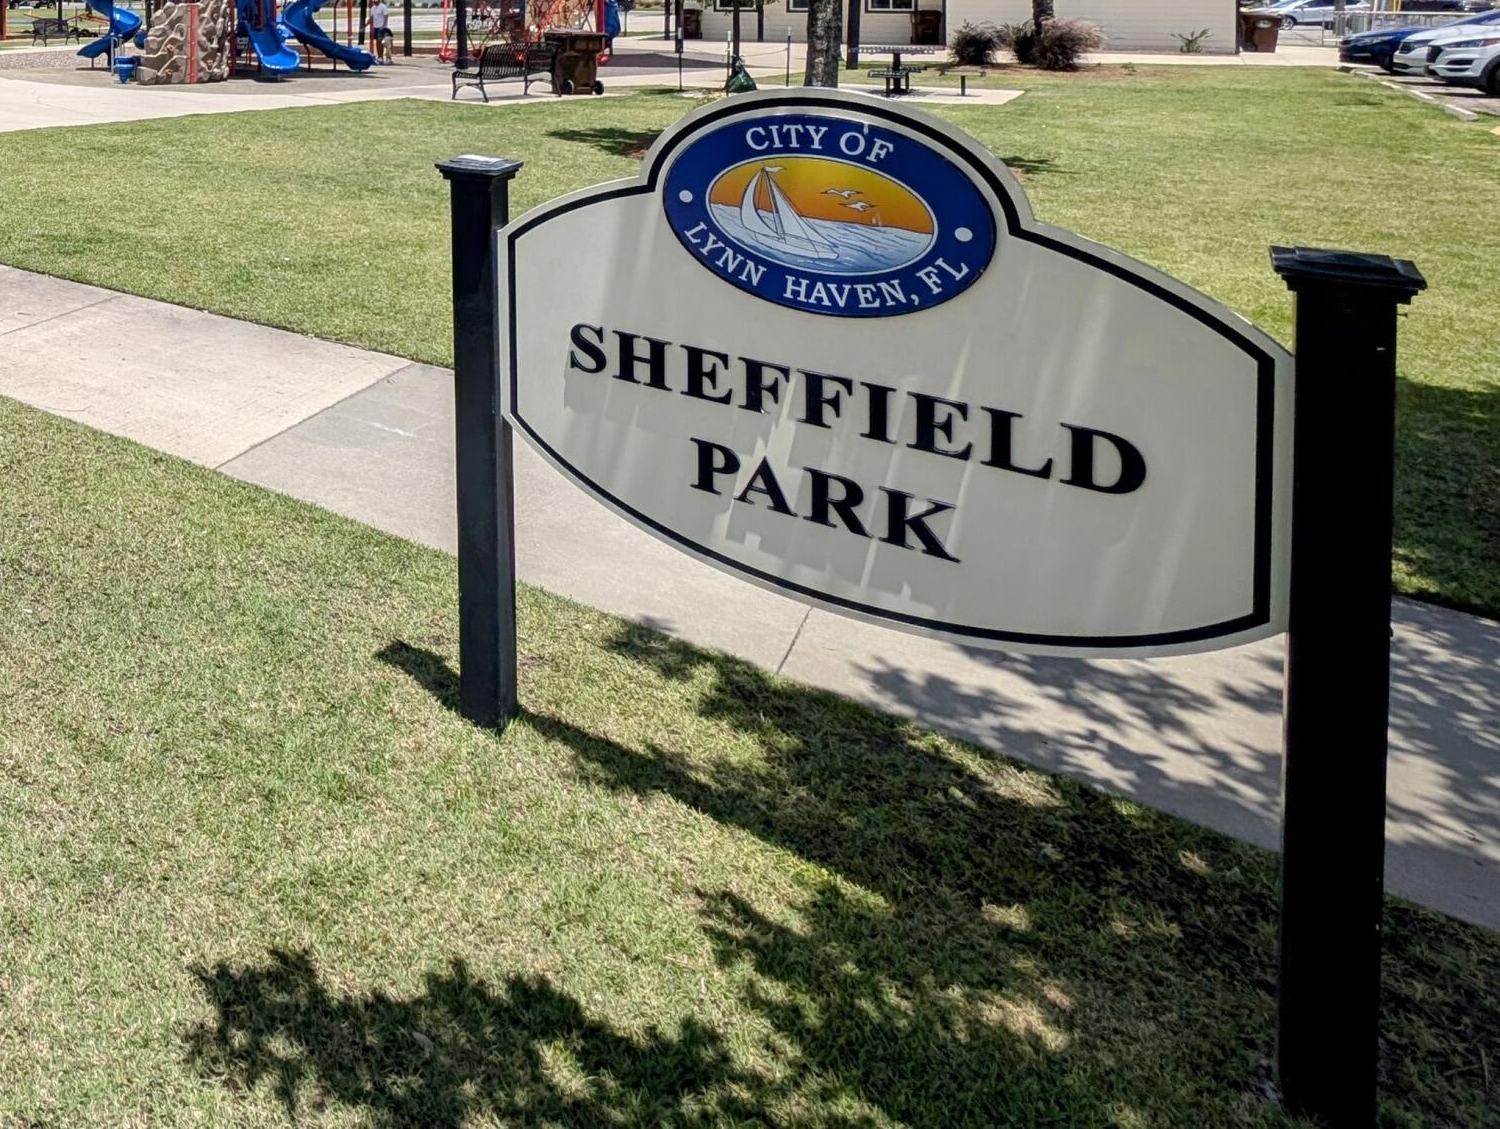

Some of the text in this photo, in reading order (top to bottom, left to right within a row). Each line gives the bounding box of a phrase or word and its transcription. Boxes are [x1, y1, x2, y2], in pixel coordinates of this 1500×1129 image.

[746, 124, 894, 162] CITY OF
[683, 221, 970, 308] LYNN HAVEN, FL
[569, 323, 1147, 495] SHEFFIELD
[690, 437, 961, 563] PARK
